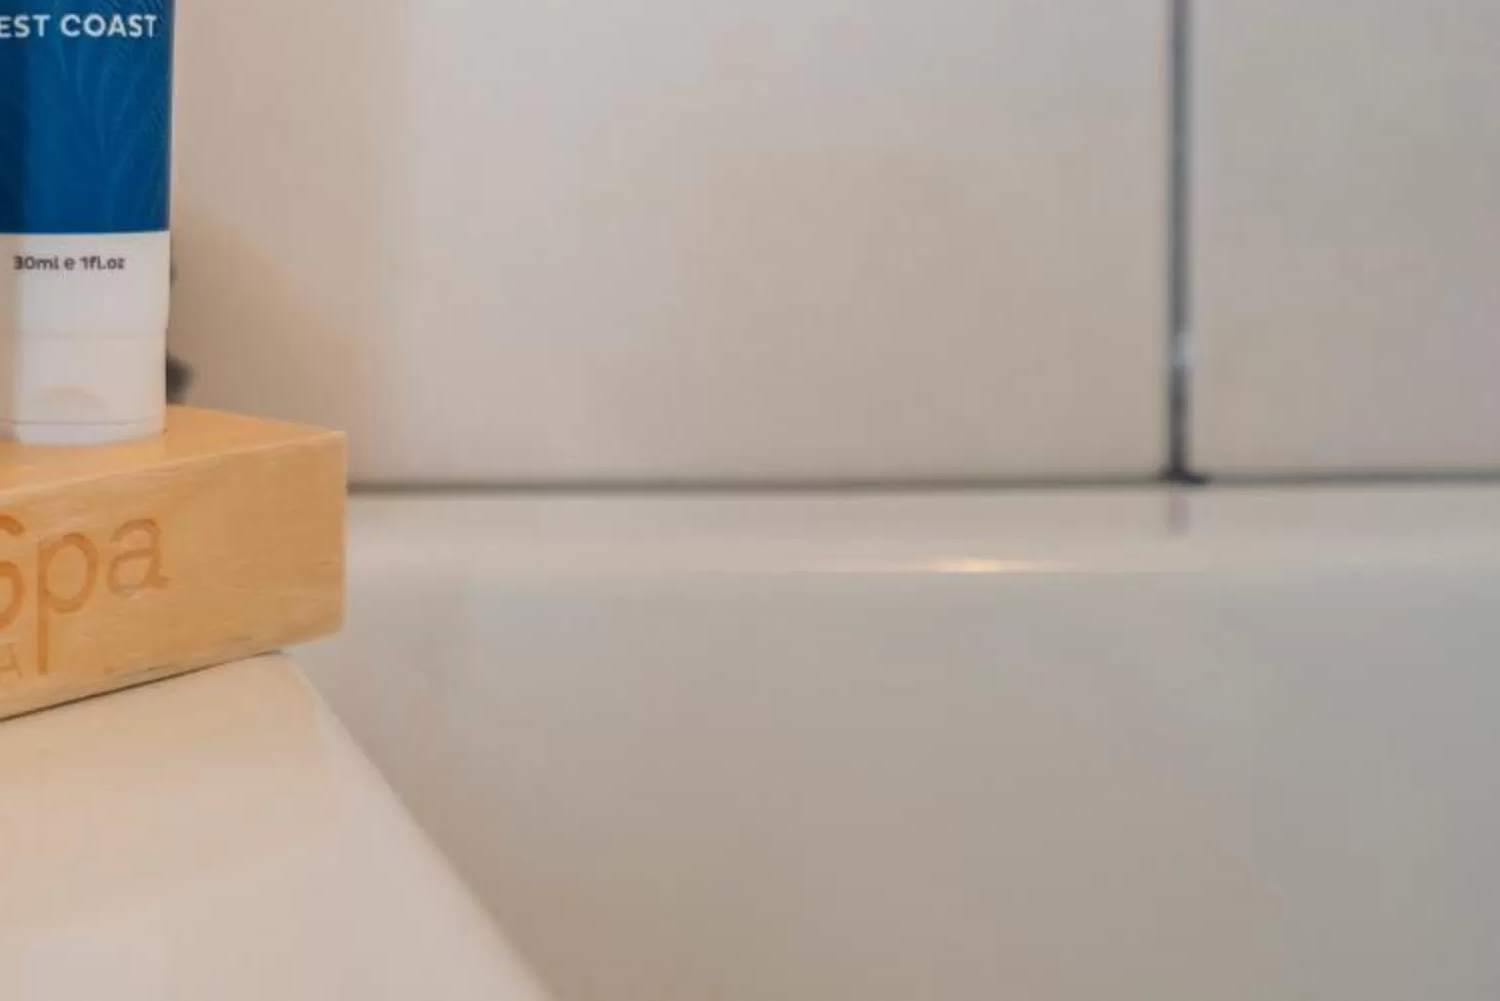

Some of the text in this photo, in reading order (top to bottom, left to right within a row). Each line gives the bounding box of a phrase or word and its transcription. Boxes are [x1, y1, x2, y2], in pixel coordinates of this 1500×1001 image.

[59, 14, 158, 39] COAST
[12, 255, 60, 270] 30ml
[81, 255, 126, 271] 1fl.oz
